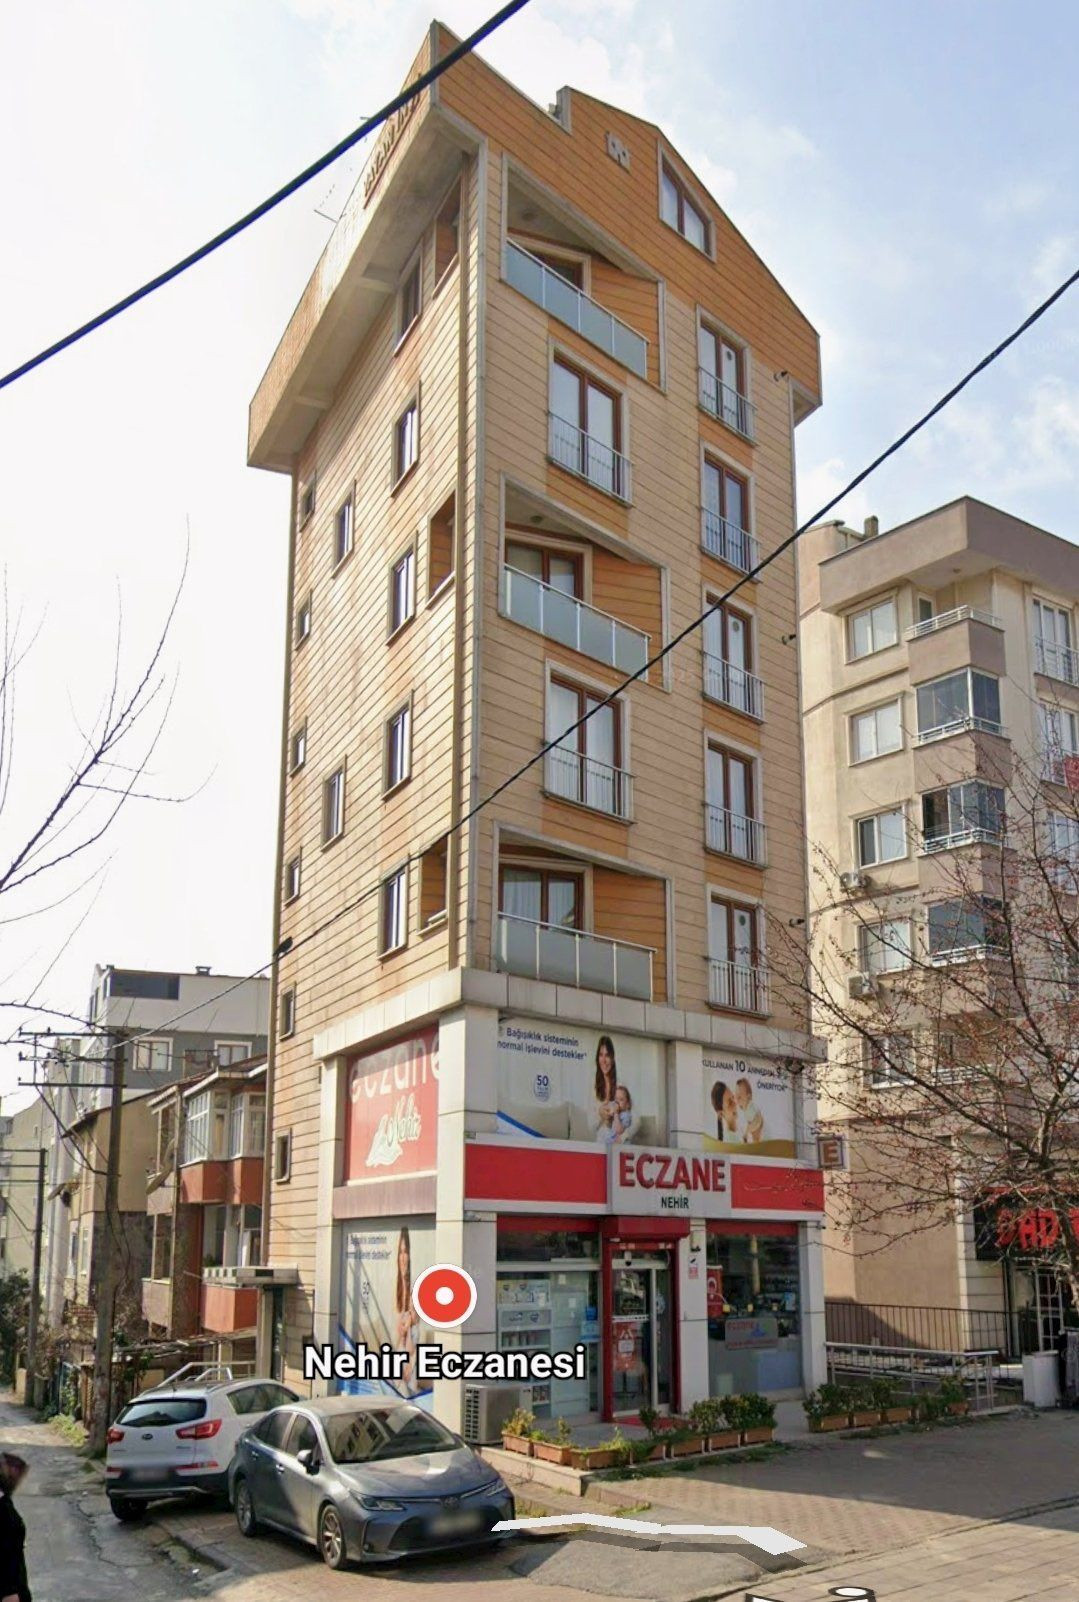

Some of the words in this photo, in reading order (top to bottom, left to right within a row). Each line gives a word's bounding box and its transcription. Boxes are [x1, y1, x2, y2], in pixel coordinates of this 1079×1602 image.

[497, 1040, 524, 1052] normal
[543, 1034, 579, 1047] sisteminin
[735, 1060, 746, 1073] 10
[537, 1074, 549, 1087] 50
[822, 1142, 839, 1165] E
[619, 1151, 726, 1193] ECZANE
[661, 1195, 690, 1209] NEHİR
